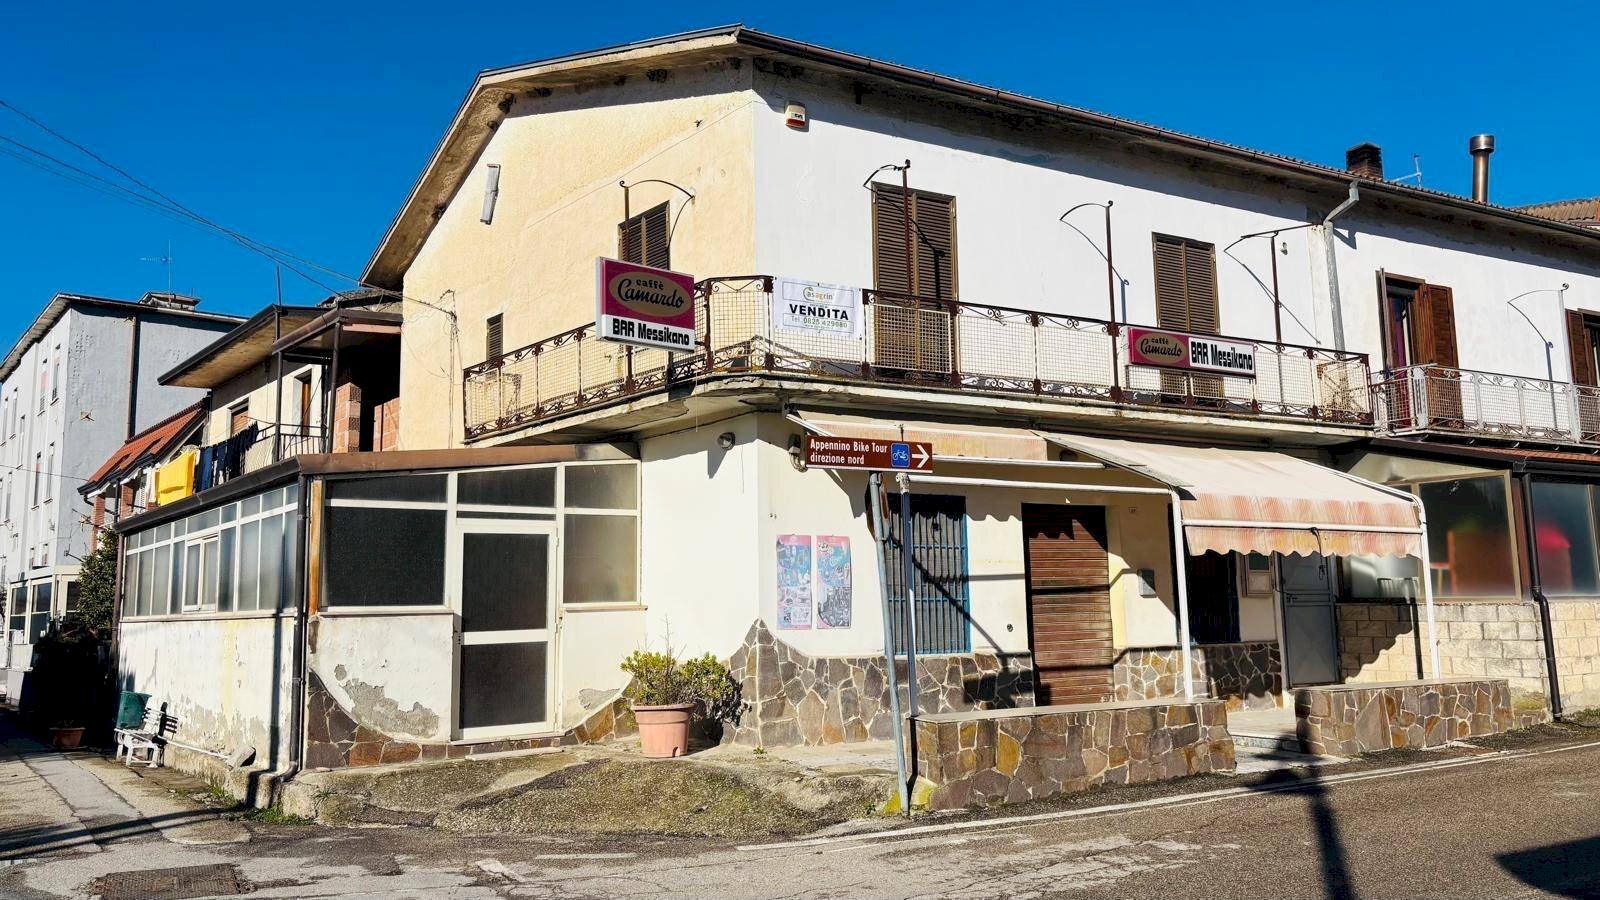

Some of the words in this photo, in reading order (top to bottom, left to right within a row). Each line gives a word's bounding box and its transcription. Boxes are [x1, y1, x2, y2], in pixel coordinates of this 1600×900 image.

[617, 278, 684, 308] Camardo
[789, 303, 849, 321] VENDITA
[612, 318, 635, 338] BAR
[637, 323, 690, 345] Messikano
[1140, 338, 1183, 357] Camardo
[1190, 341, 1209, 365] BAR
[1210, 344, 1253, 371] Messikano
[810, 438, 851, 451] Appennino
[853, 441, 870, 453] Bike
[871, 442, 888, 453] Tour
[810, 452, 846, 464] direzione
[847, 455, 865, 465] nord
